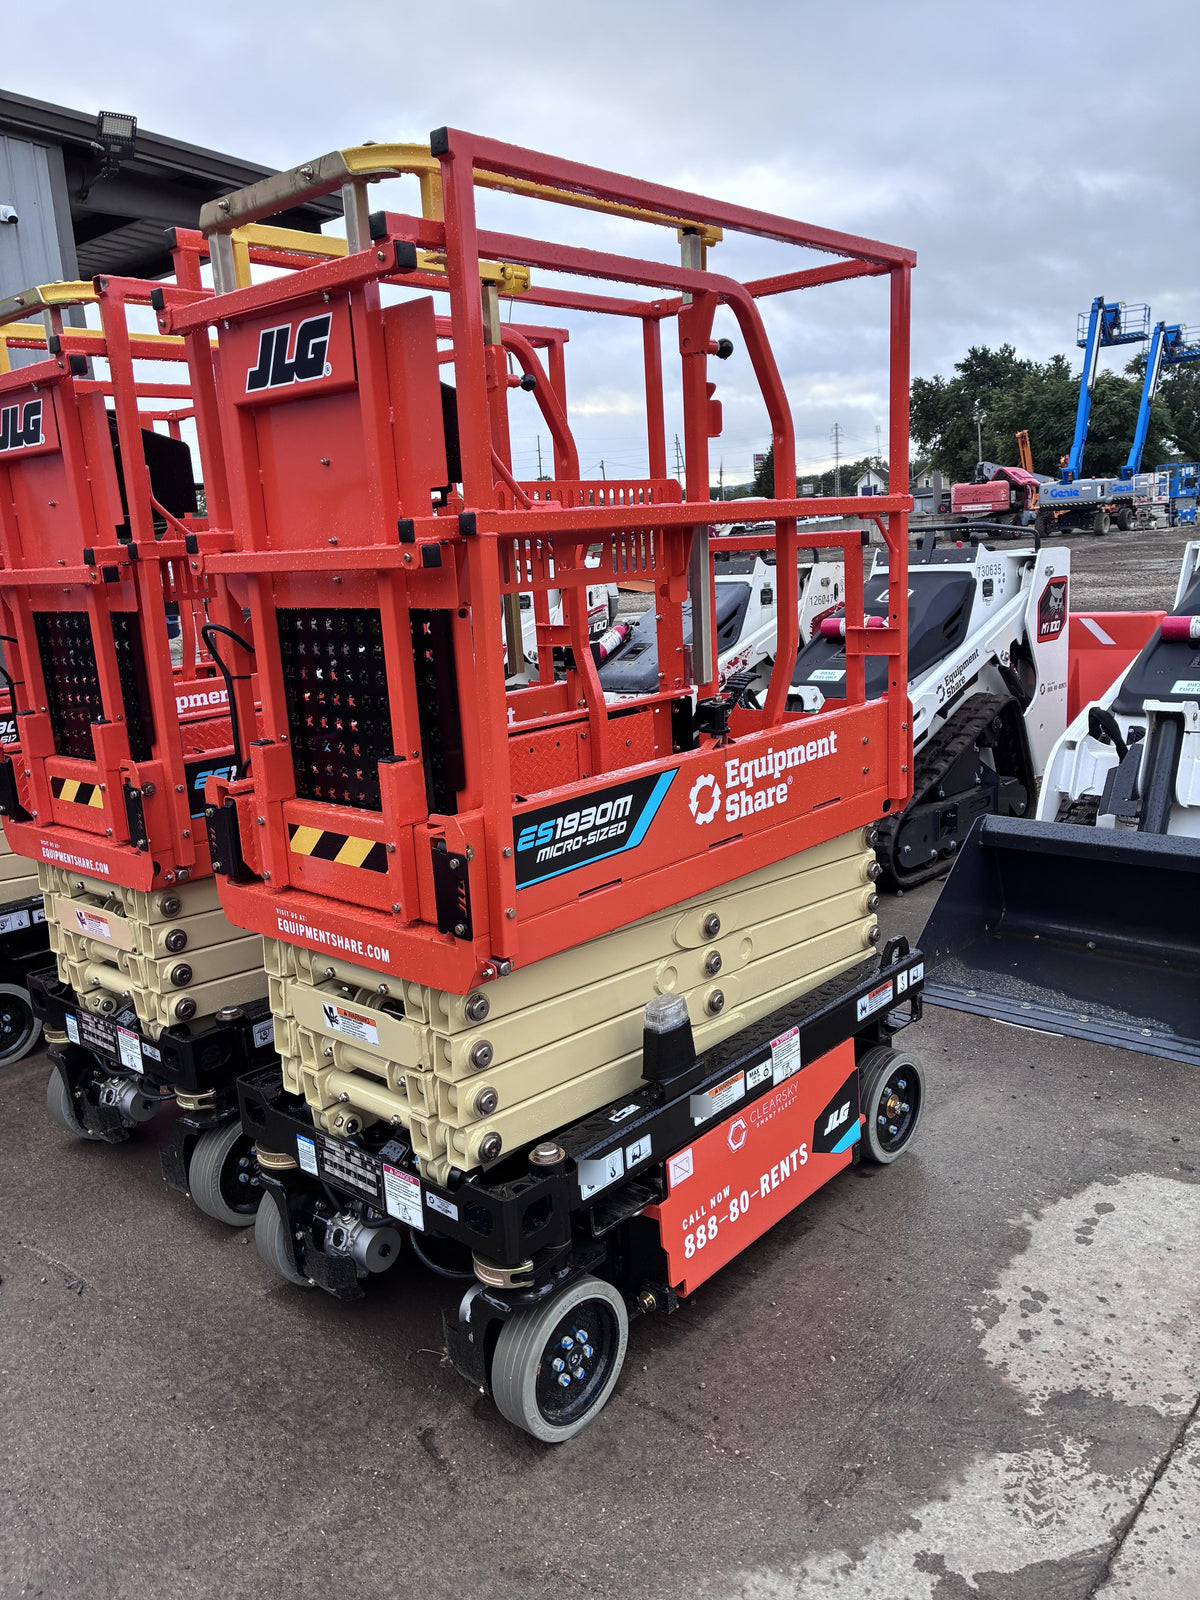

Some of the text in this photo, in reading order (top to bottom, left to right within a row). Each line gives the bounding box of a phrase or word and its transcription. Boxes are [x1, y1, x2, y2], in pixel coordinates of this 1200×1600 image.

[246, 312, 333, 393] JLG
[1050, 488, 1079, 498] Genie
[977, 563, 1002, 578] 730635
[944, 648, 979, 687] Equipment
[946, 675, 966, 698] Share
[725, 730, 838, 788] Equipment
[517, 794, 633, 852] ES1930M
[725, 782, 788, 823] Share
[41, 847, 109, 875] EQUIPMENTSHARE.COM
[536, 820, 627, 863] MICRO-SIZED
[277, 917, 390, 963] EQUIPMENTSHARE.COM
[749, 1068, 760, 1078] MAX
[750, 1080, 799, 1123] CLEARSKY
[823, 1101, 851, 1136] JLG
[682, 1185, 731, 1231] CALL NOW
[684, 1142, 809, 1259] 888-80-RENTS
